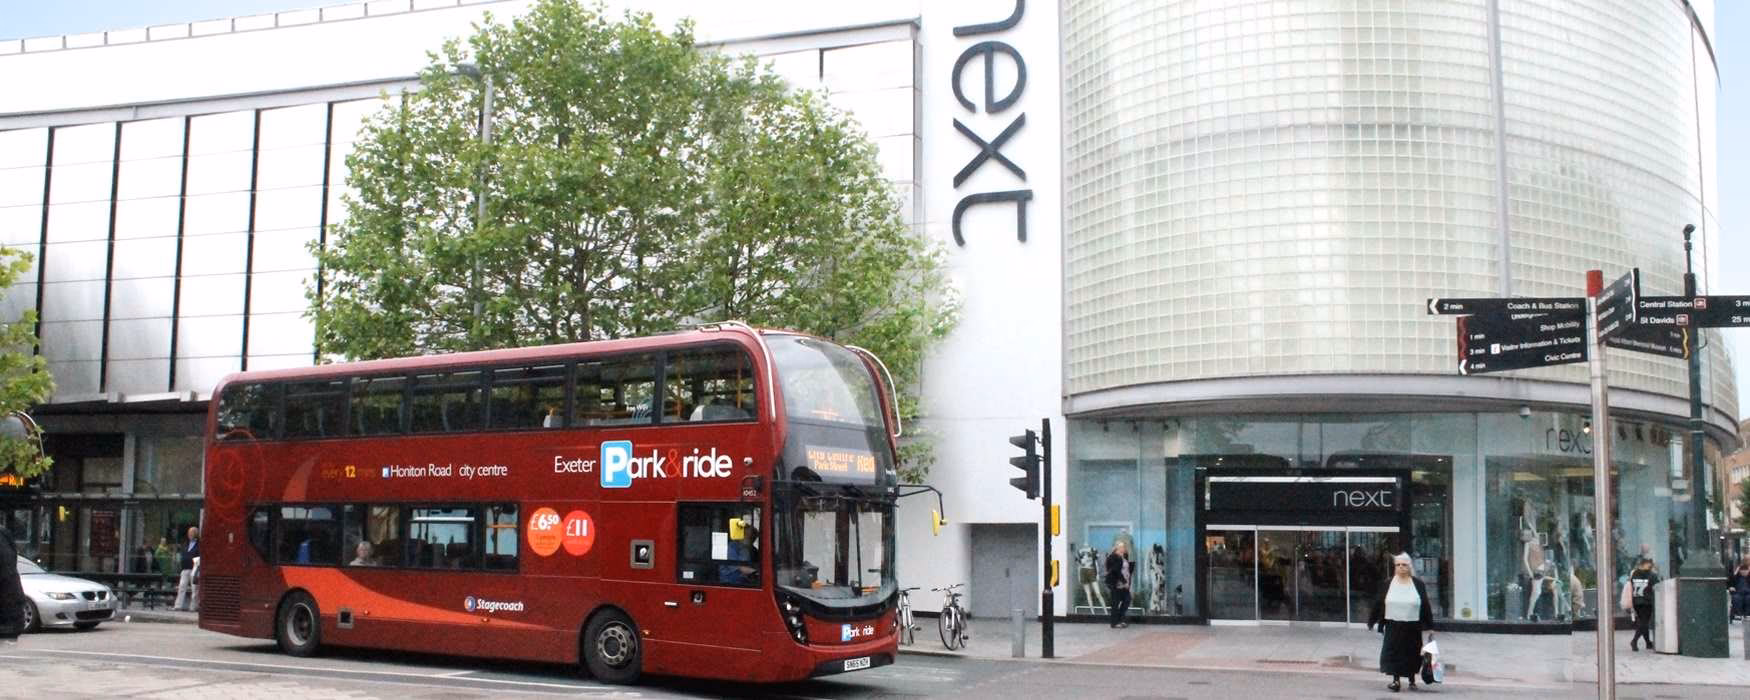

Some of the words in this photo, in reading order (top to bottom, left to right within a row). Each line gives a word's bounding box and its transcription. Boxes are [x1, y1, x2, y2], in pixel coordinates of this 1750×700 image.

[1554, 302, 1580, 310] Station
[345, 465, 356, 478] 12
[390, 465, 427, 478] Honiton
[428, 464, 452, 477] Road
[459, 464, 475, 481] city
[477, 464, 508, 477] centre
[554, 456, 597, 473] Exeter
[1333, 489, 1392, 507] next
[476, 598, 524, 613] Stagecoach
